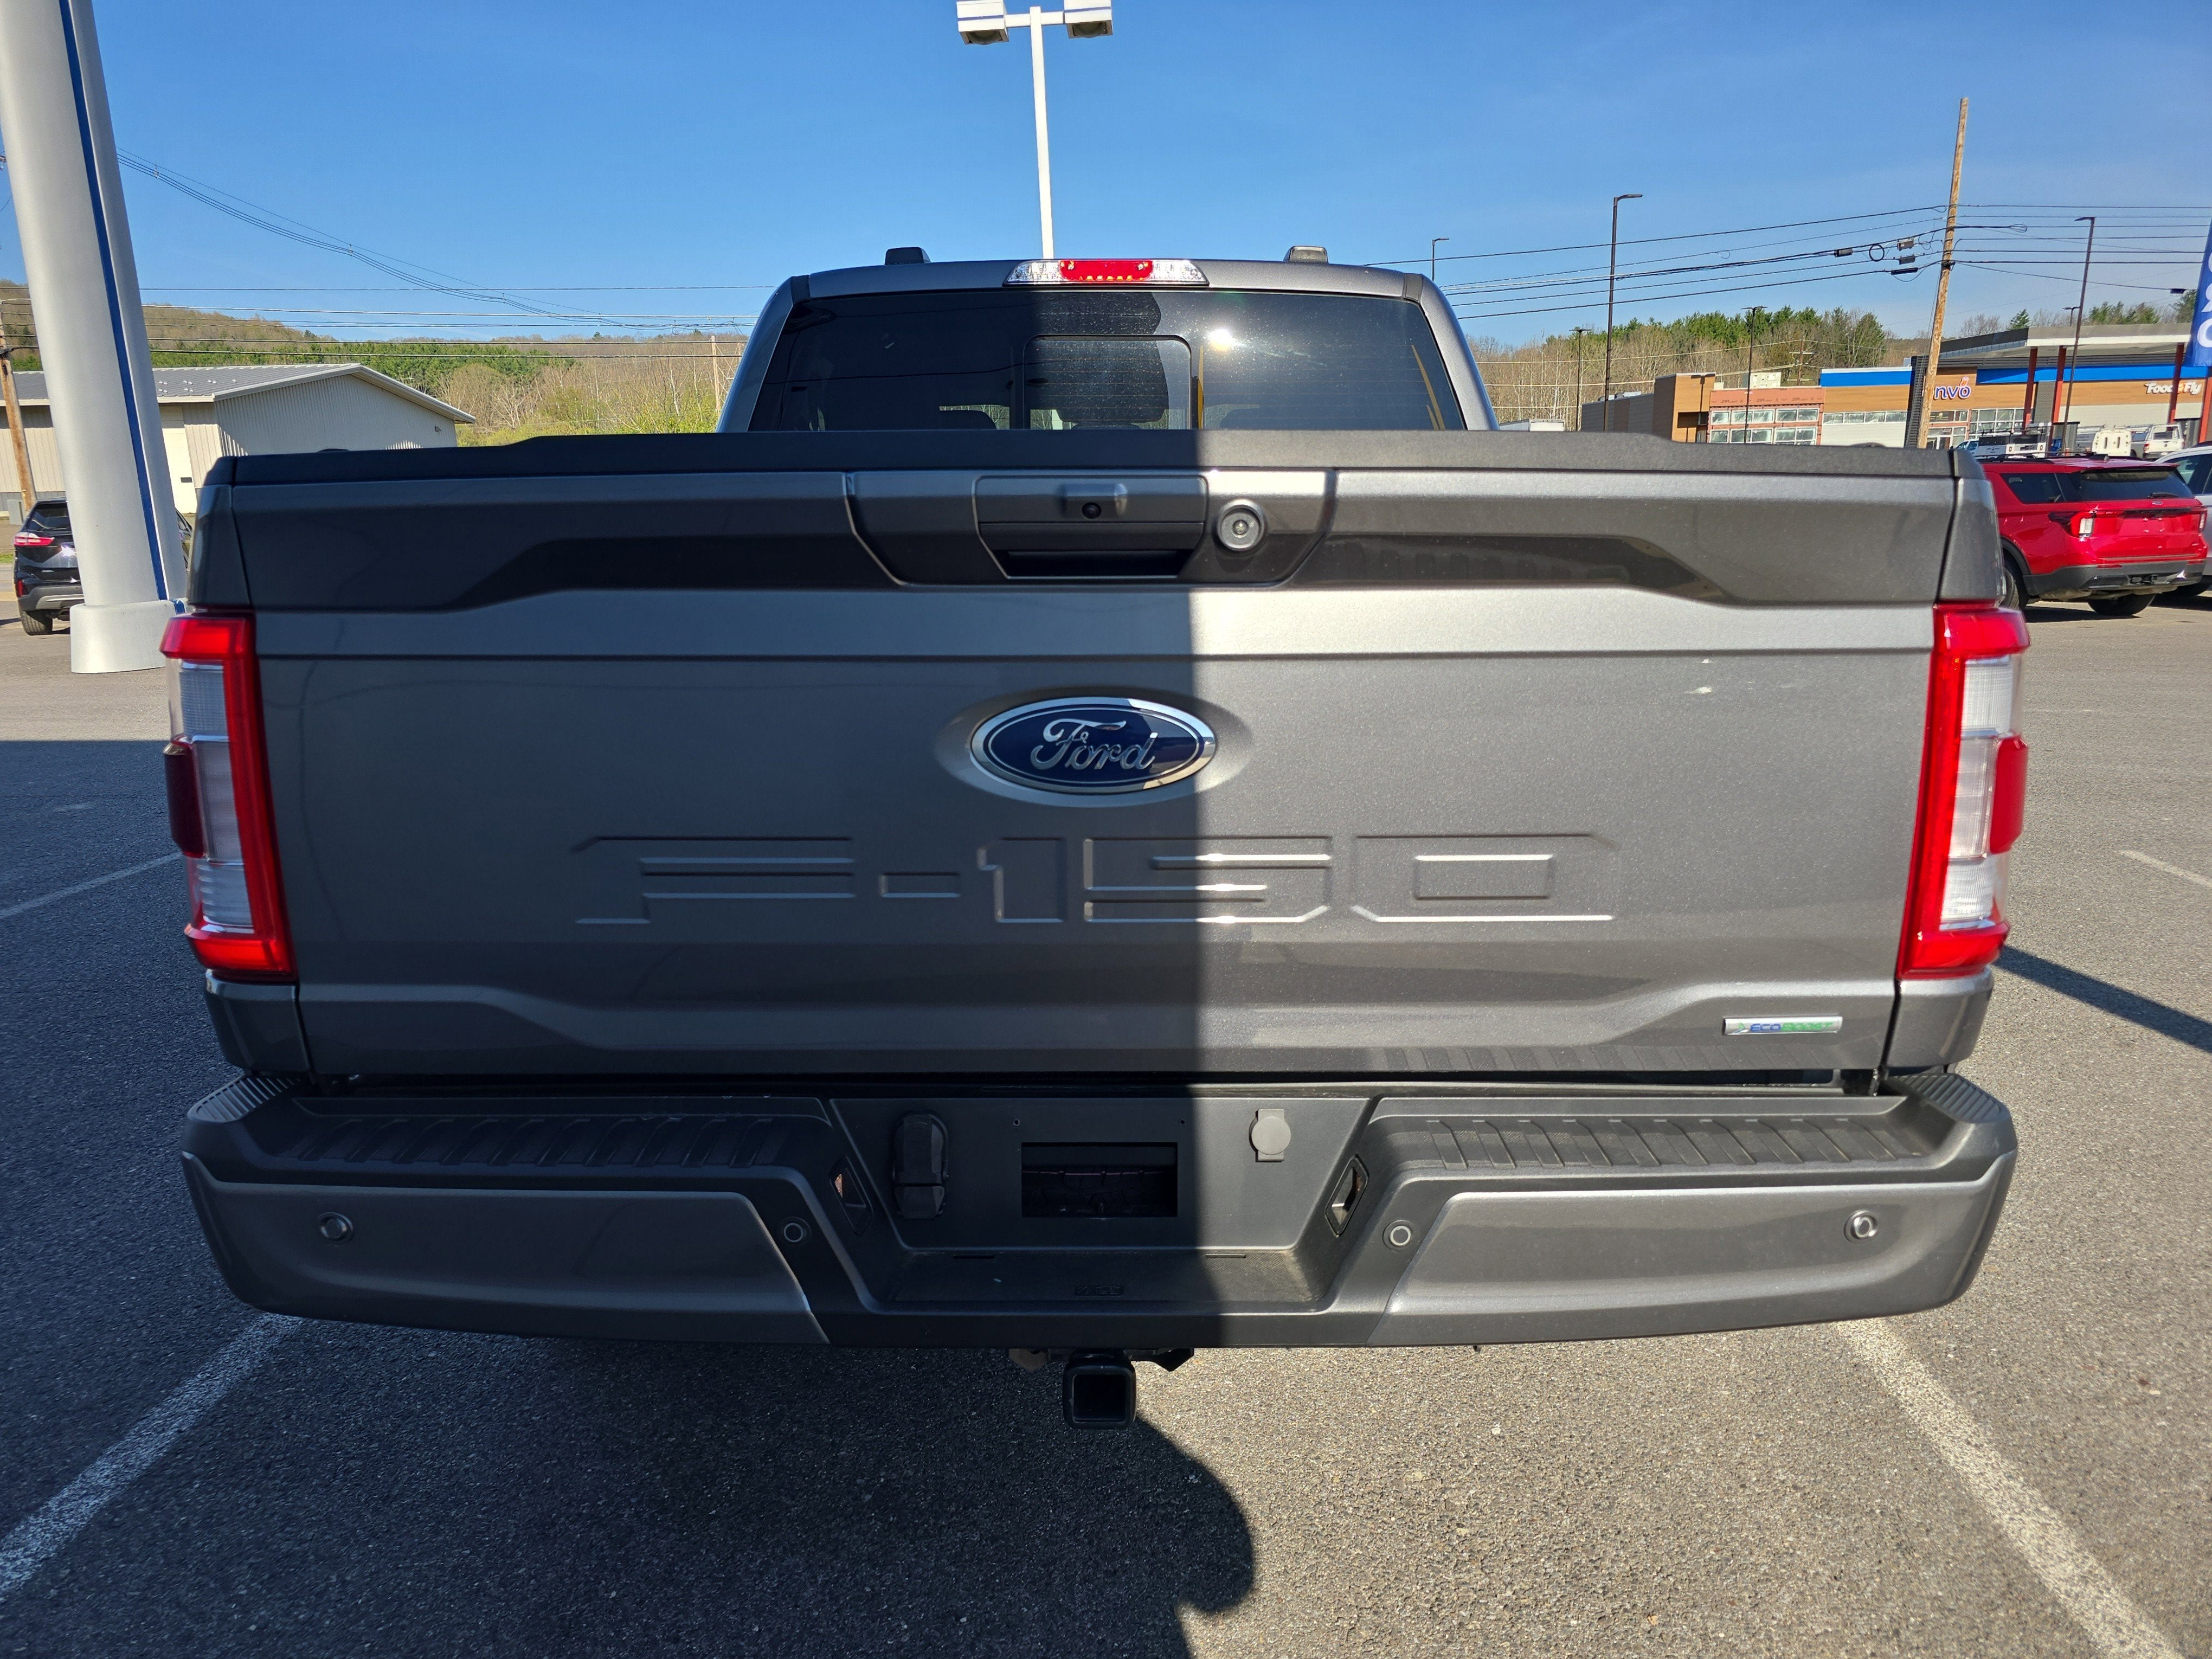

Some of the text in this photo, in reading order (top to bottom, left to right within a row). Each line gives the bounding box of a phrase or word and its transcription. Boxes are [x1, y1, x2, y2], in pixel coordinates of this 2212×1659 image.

[1933, 376, 1972, 400] nvo
[2183, 382, 2202, 395] Fly
[1030, 718, 1159, 771] Ford
[570, 835, 1620, 924] F-150
